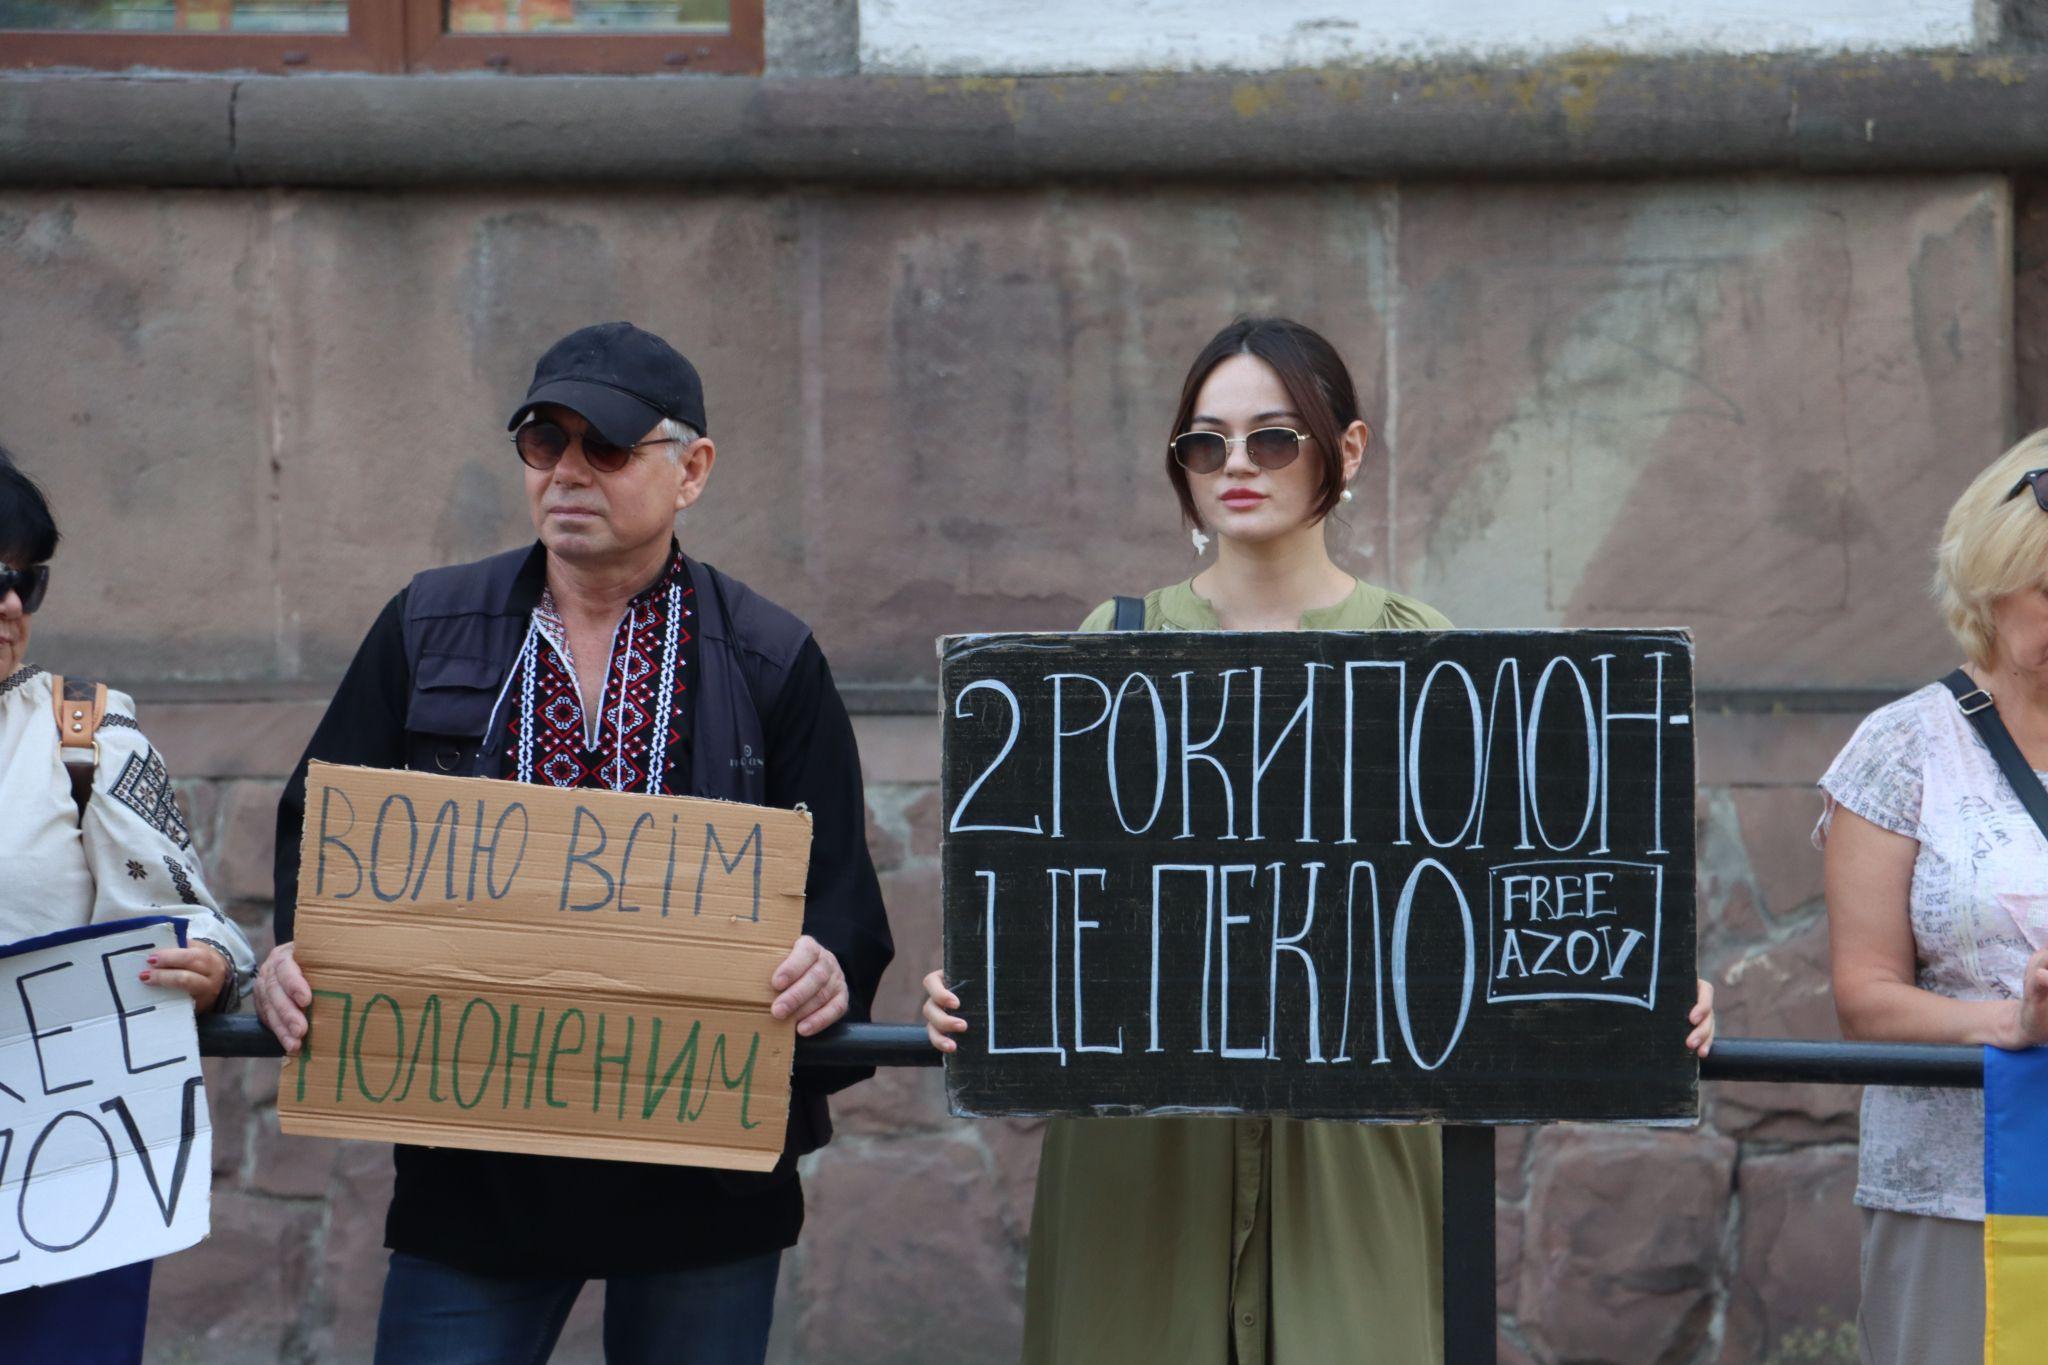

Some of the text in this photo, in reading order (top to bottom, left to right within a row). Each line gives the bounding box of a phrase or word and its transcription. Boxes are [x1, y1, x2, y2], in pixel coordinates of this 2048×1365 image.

[949, 679, 1042, 834] 2
[1043, 662, 1334, 843] РОКИ
[314, 786, 763, 922] ВОЛЮ ВСІМ
[1501, 872, 1617, 922] FREE
[0, 944, 187, 1101] EE
[975, 858, 1475, 1071] ЦЕ ПЕКЛО
[1496, 925, 1647, 981] AZOV
